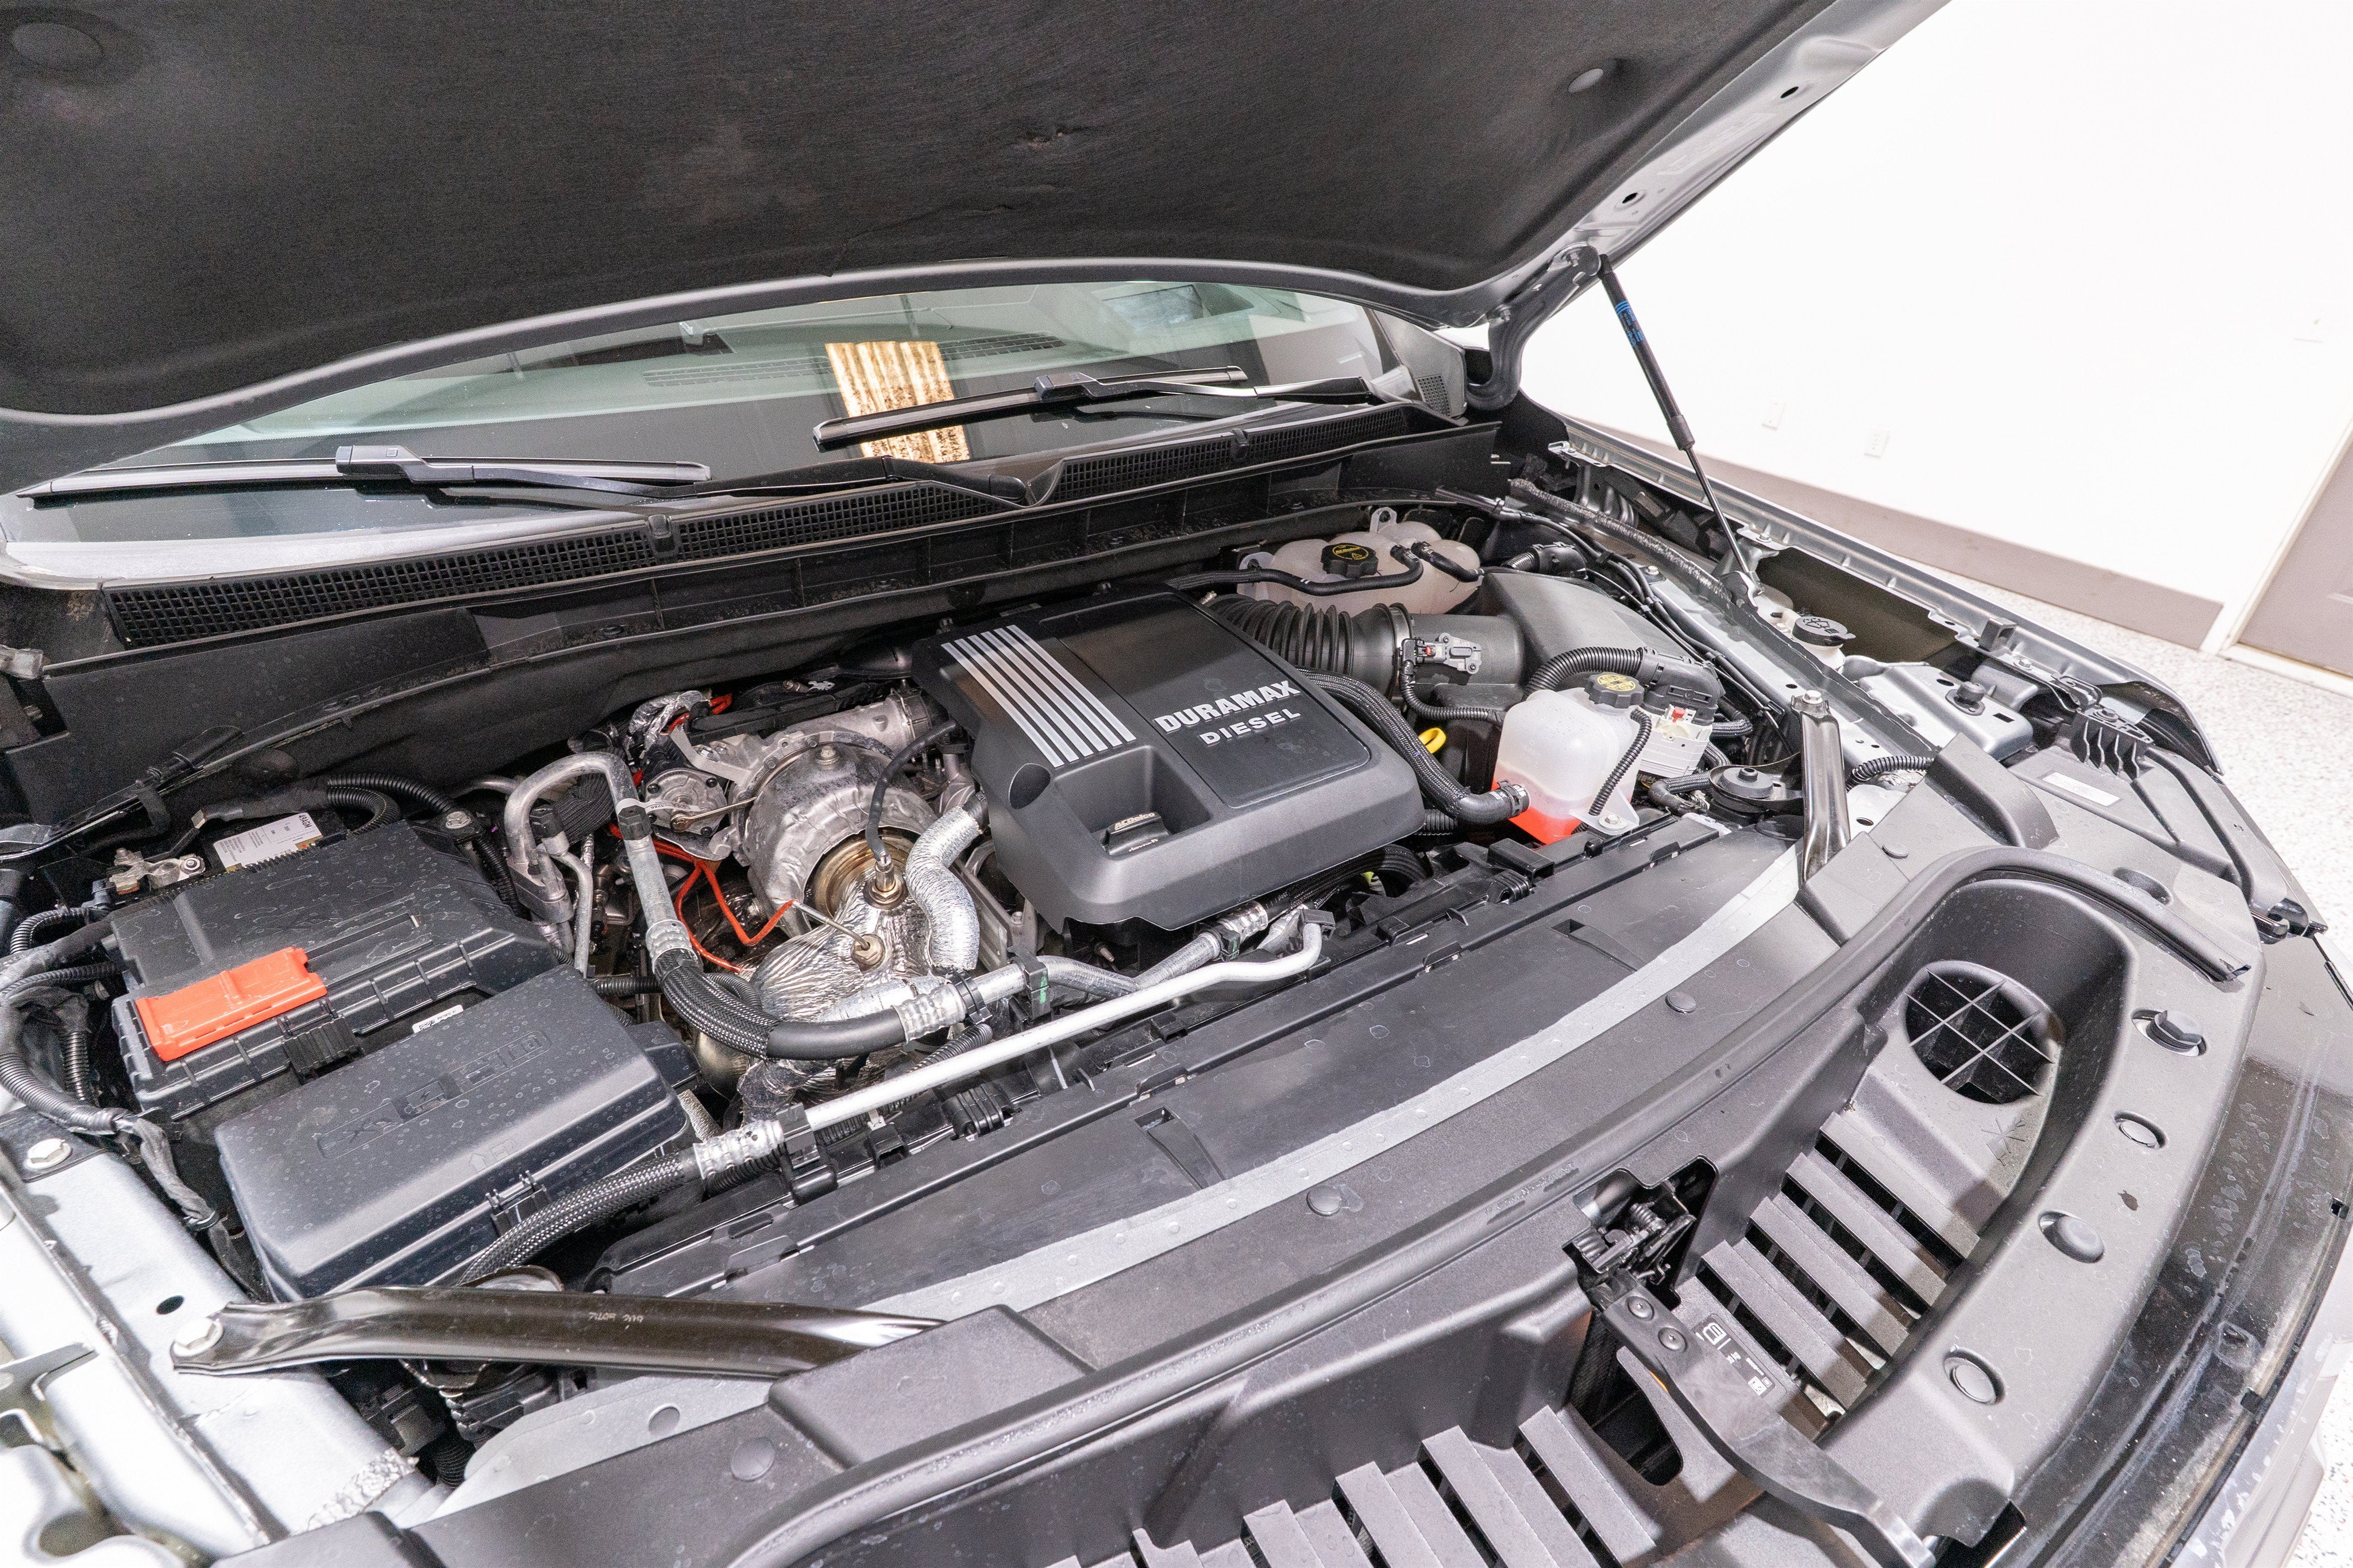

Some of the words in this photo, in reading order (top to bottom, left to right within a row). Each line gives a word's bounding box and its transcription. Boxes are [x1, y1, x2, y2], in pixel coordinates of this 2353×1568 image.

[1154, 680, 1301, 733] DURAMAX
[1199, 708, 1301, 746] DIESEL
[298, 814, 313, 829] 49AGM
[1114, 813, 1156, 831] ACDelco
